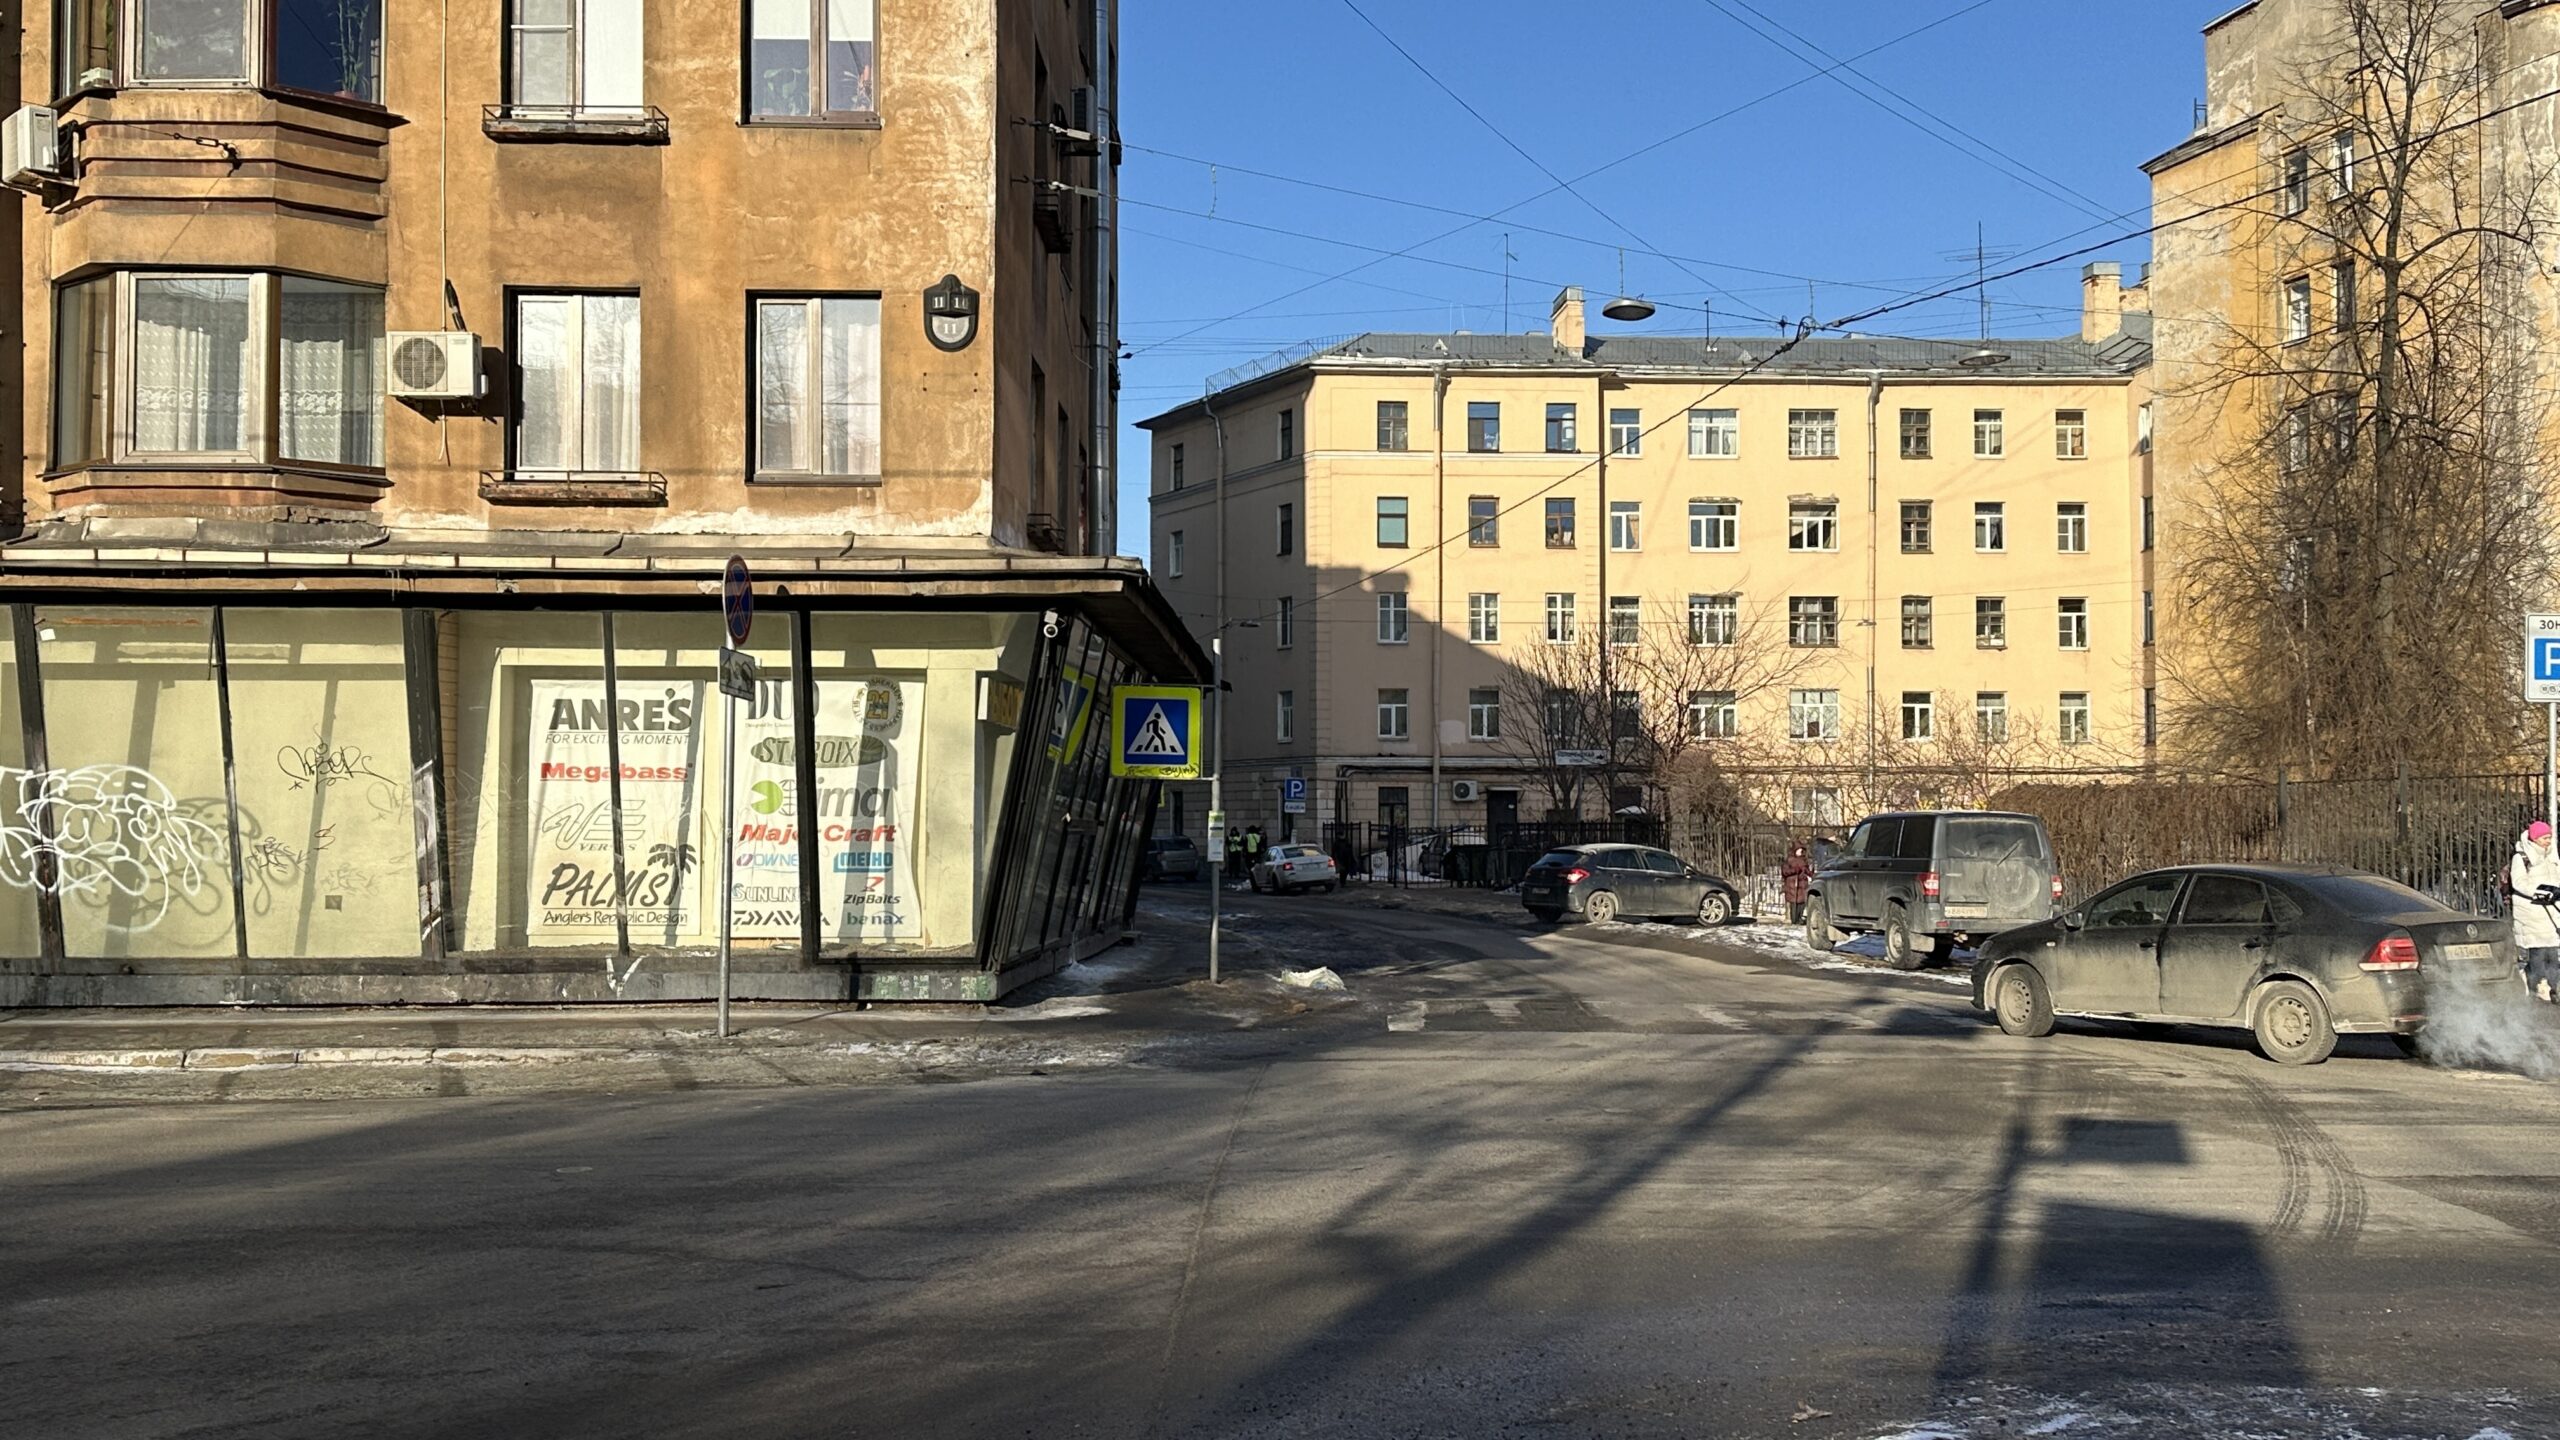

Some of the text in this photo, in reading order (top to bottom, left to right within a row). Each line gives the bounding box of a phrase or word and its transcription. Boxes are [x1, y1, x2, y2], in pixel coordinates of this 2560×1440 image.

[944, 323, 957, 335] 11
[745, 678, 820, 721] DU
[545, 734, 570, 744] FOR
[573, 734, 630, 744] EXCITG
[1291, 780, 1303, 798] P
[823, 824, 896, 843] Craft
[839, 852, 893, 867] MEIHO
[732, 883, 800, 903] SUNLIN
[594, 911, 644, 924] Repblic
[646, 911, 688, 927] Design
